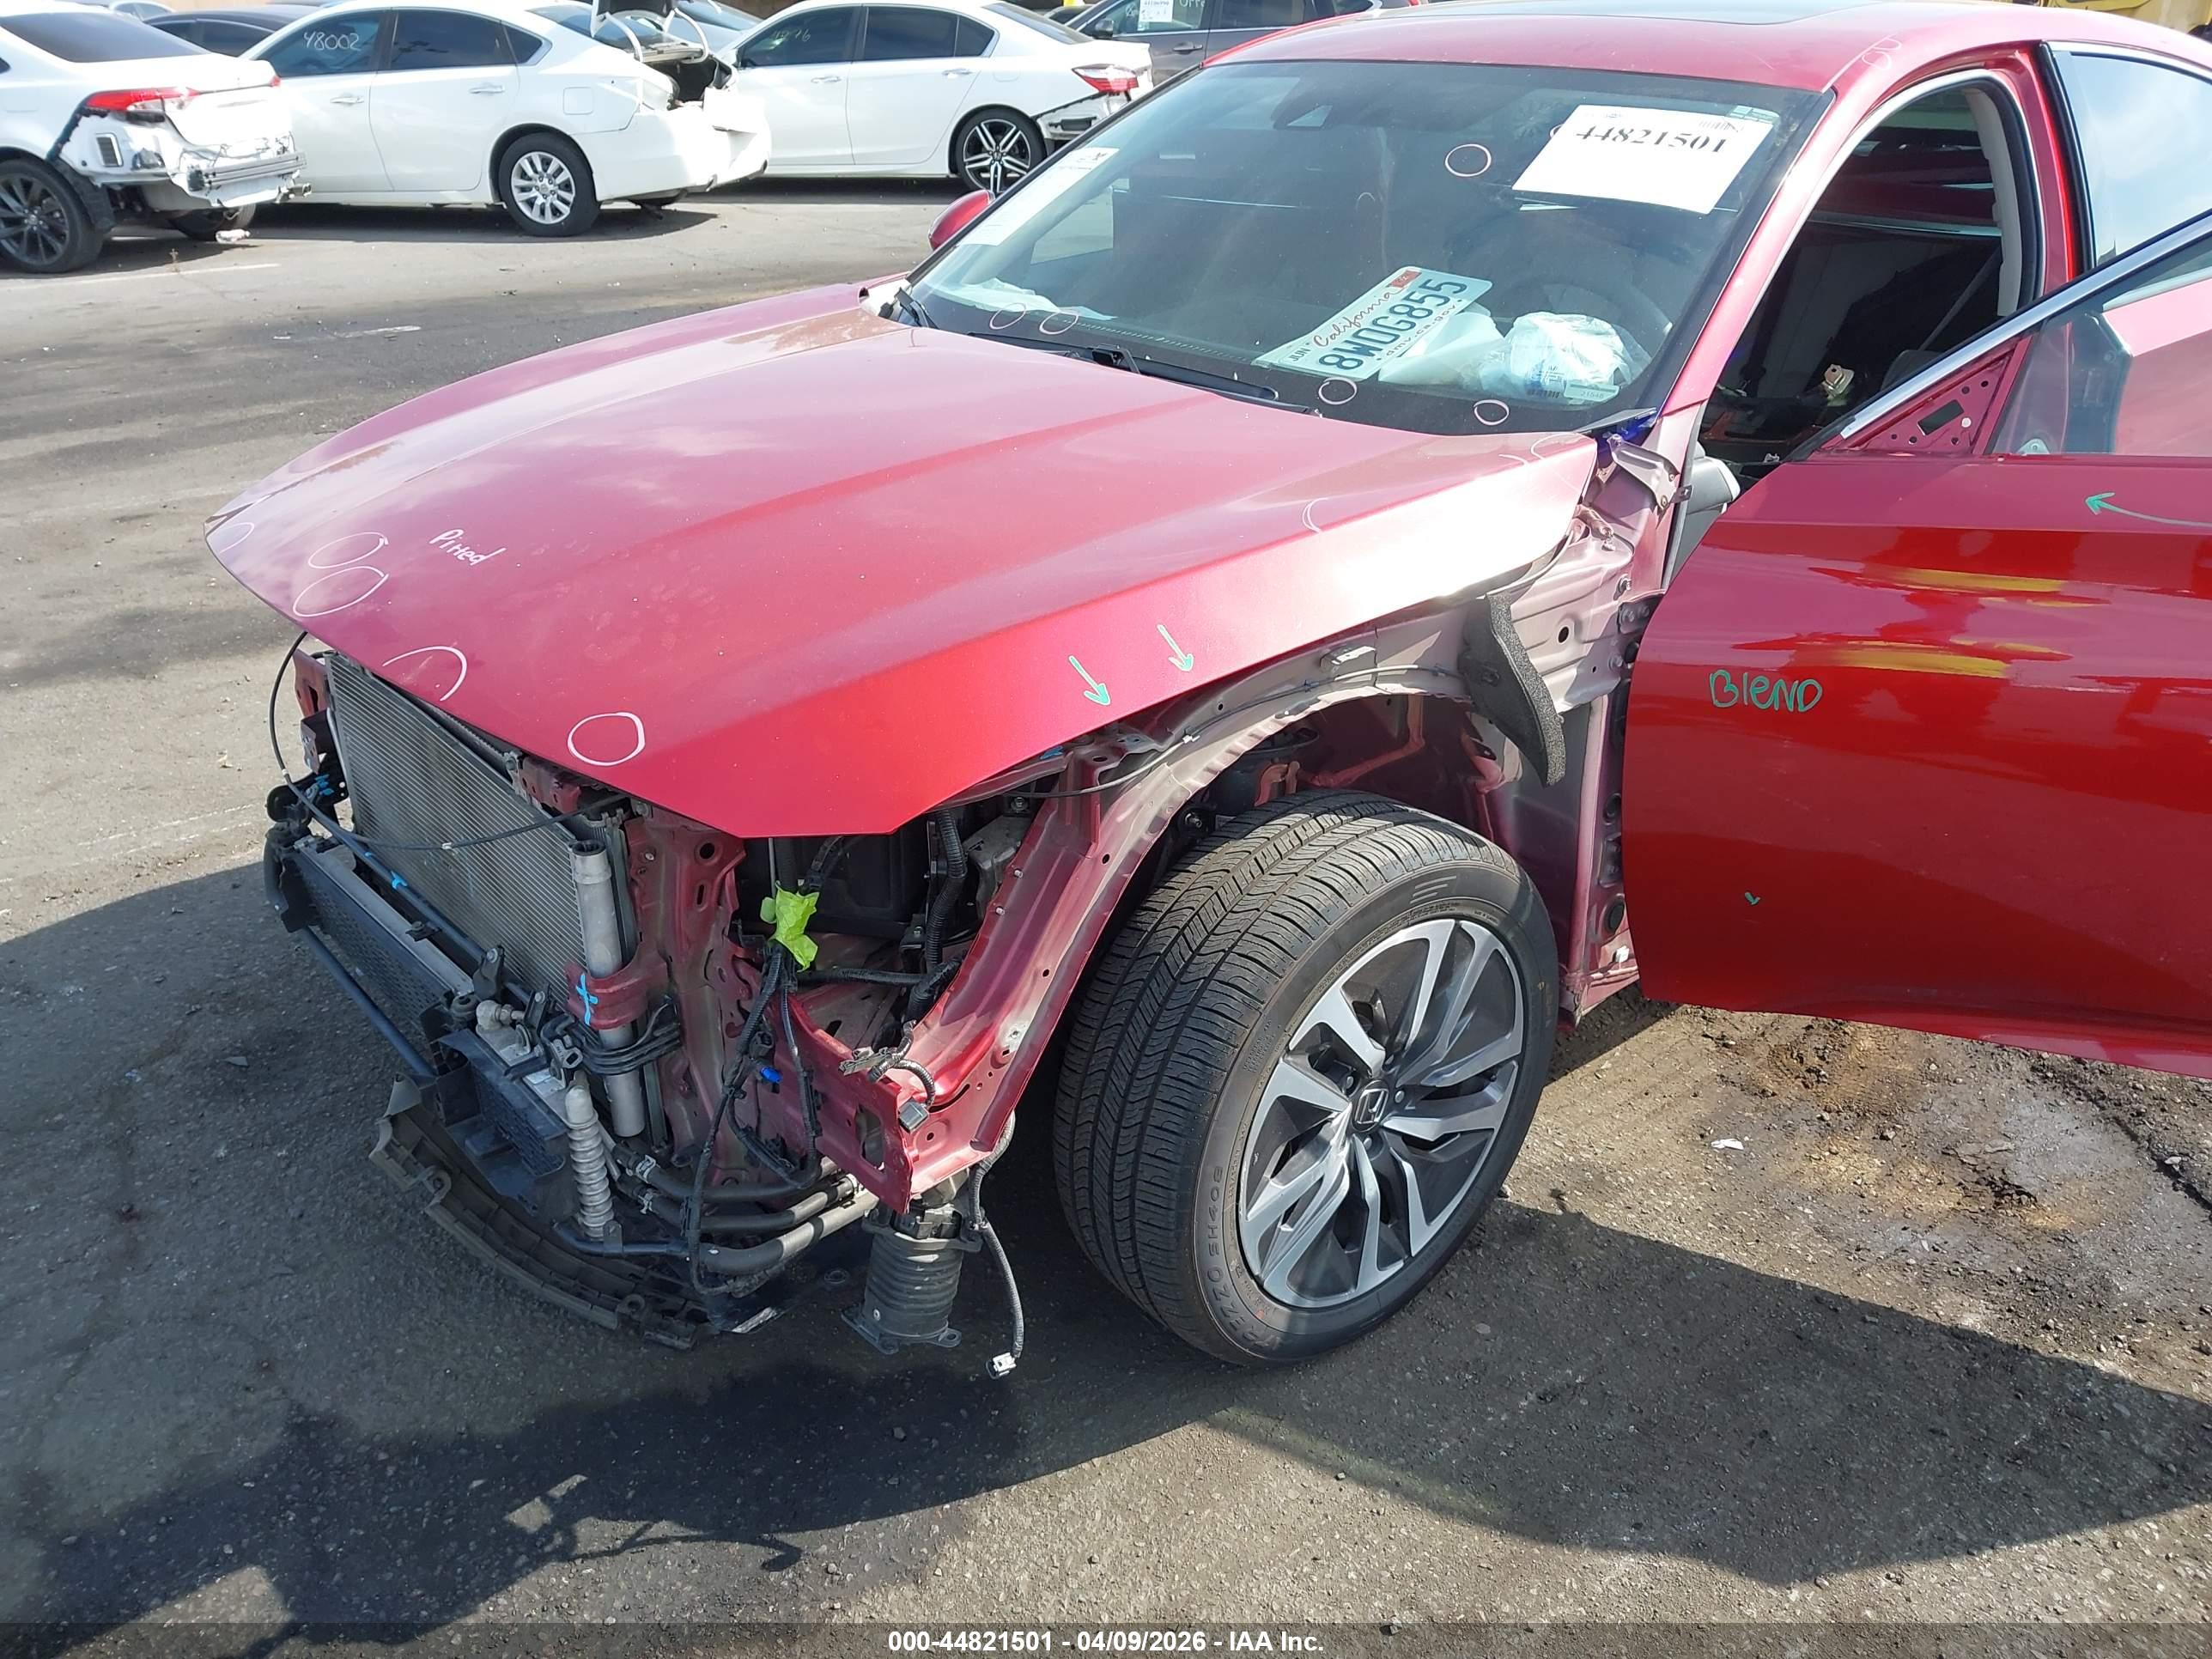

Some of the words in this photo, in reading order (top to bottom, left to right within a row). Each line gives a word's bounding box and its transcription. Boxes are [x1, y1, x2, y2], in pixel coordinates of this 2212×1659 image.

[303, 31, 362, 51] 48002
[1576, 125, 1727, 153] 44821501
[1313, 287, 1407, 347] California
[1287, 347, 1312, 362] JUN
[1207, 1166, 1224, 1257] SH408
